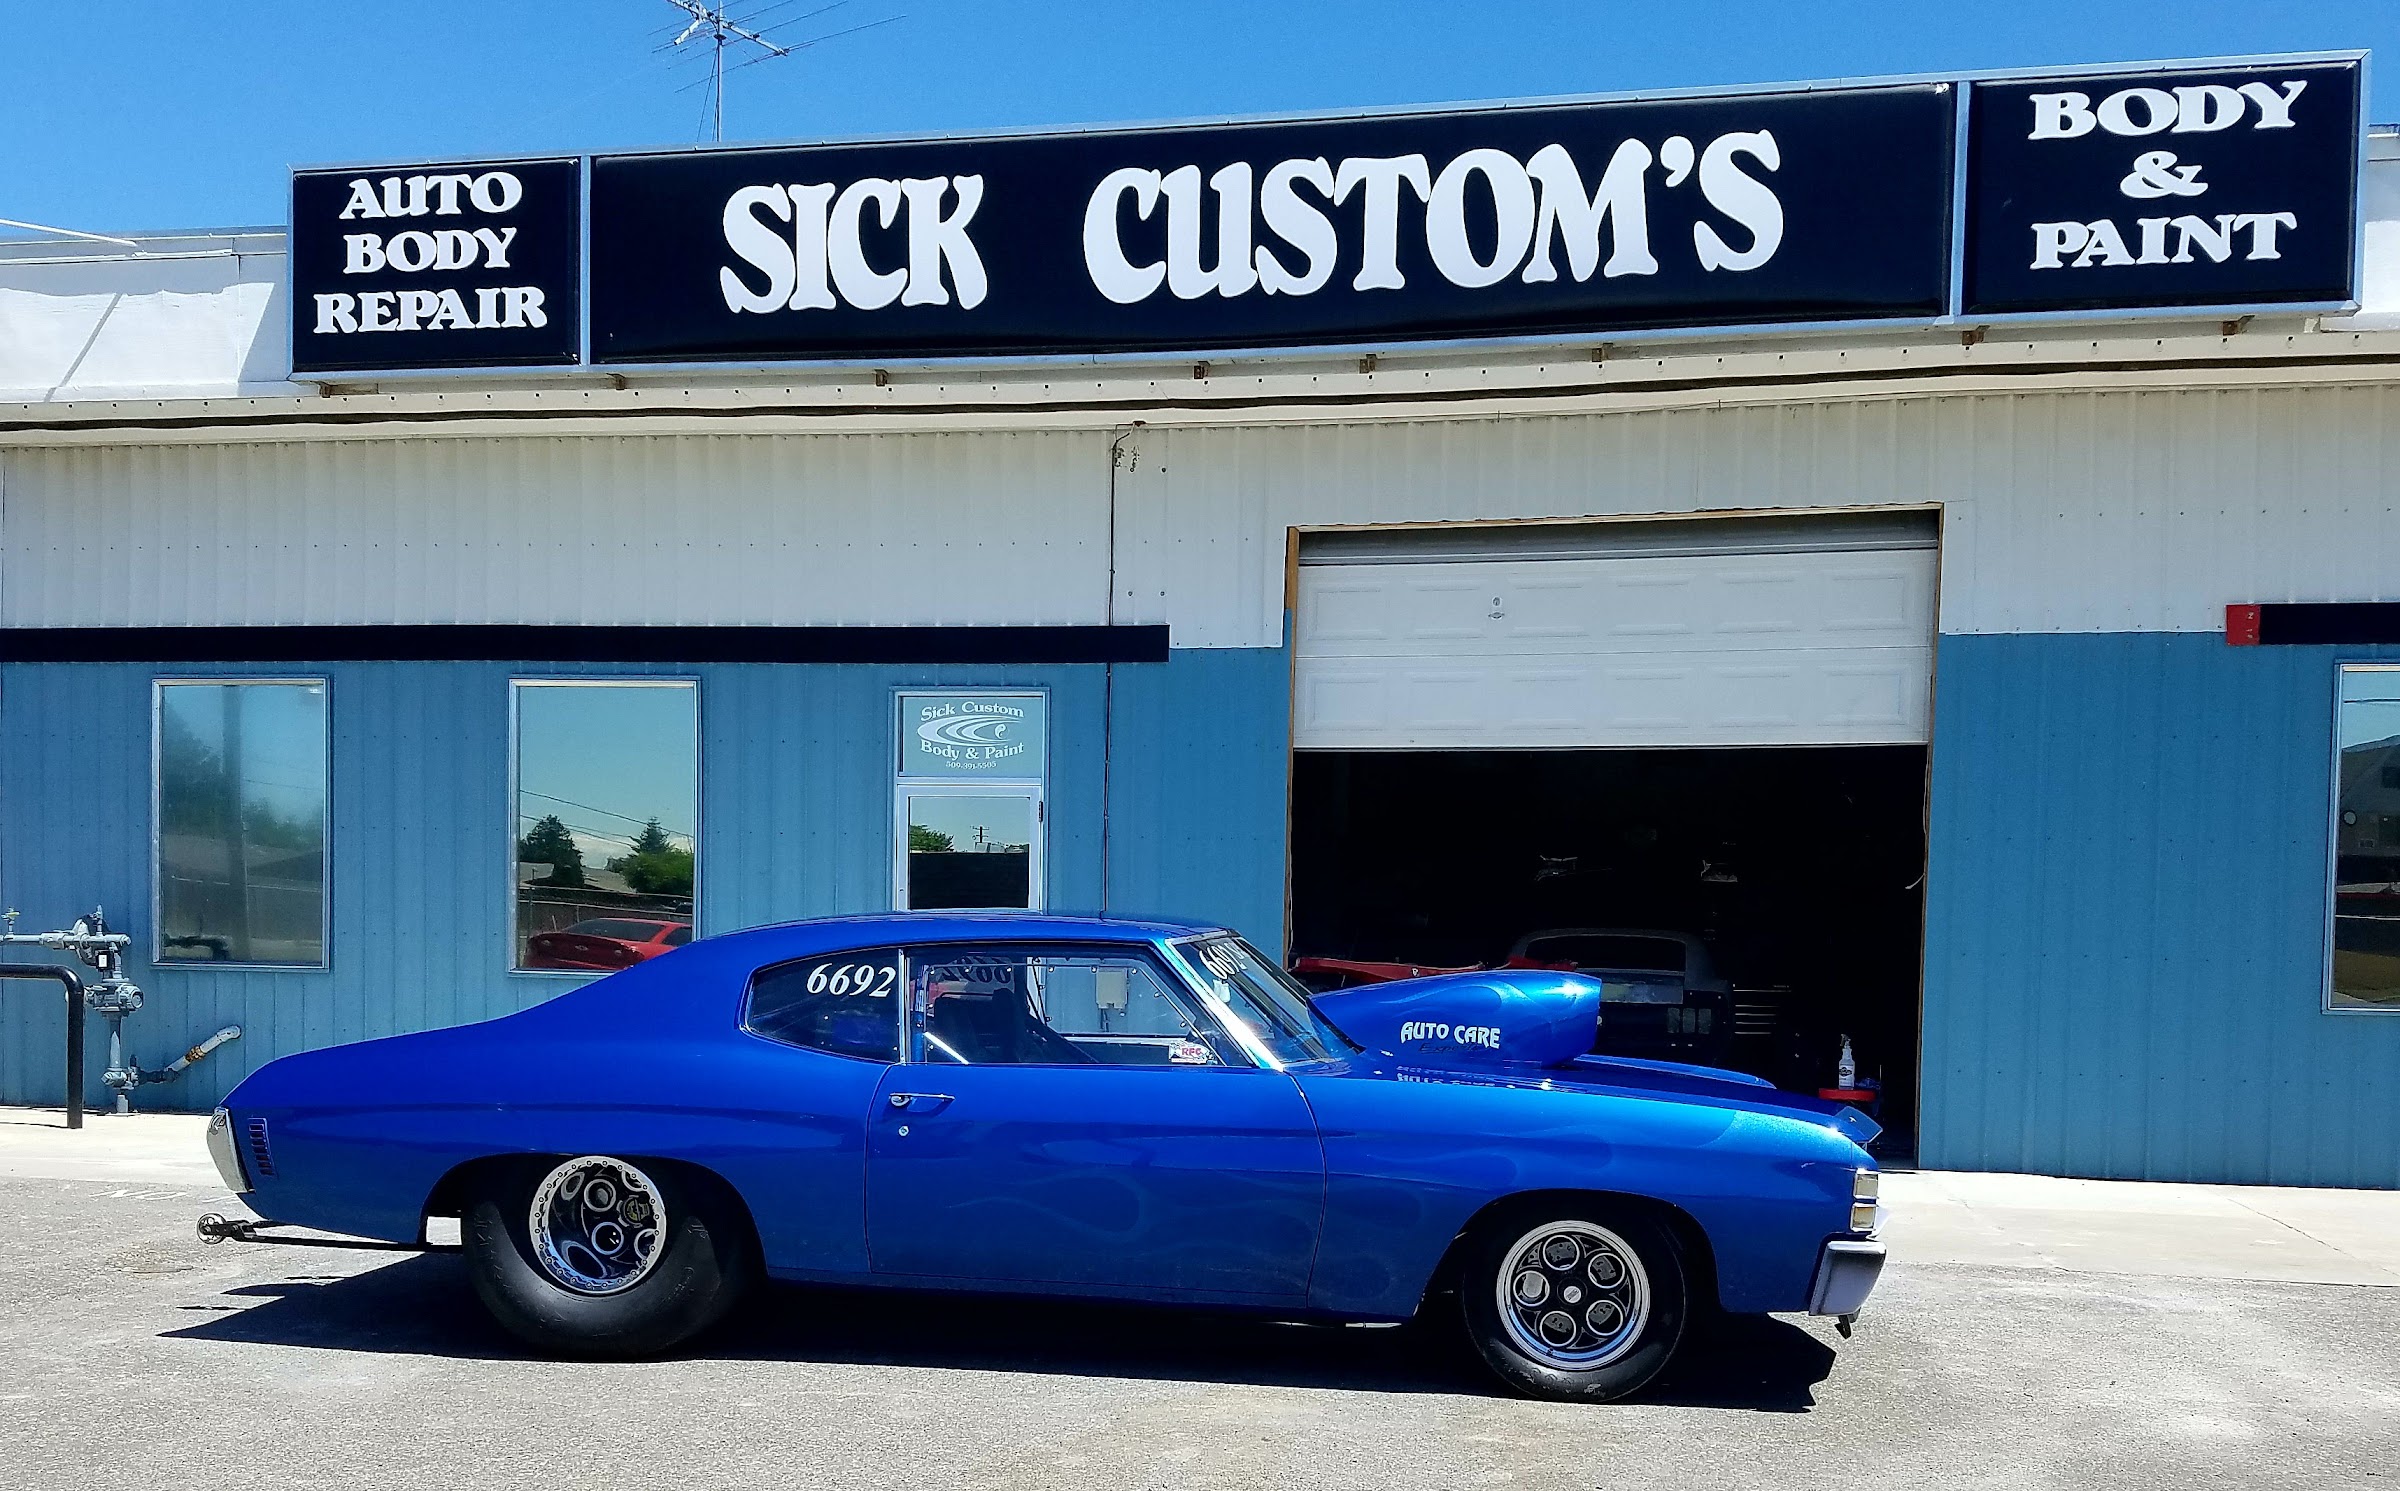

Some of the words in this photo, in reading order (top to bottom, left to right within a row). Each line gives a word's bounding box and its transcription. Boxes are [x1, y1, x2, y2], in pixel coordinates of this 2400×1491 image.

[2028, 80, 2308, 140] BODY
[338, 171, 522, 220] AUTO
[2120, 150, 2208, 199] &
[720, 174, 988, 314] SICK
[1083, 128, 1784, 304] CUSTOM'S
[2029, 211, 2298, 270] PAINT
[343, 227, 517, 274] BODY
[313, 287, 548, 335] REPAIR
[921, 703, 956, 721] Sick
[961, 701, 1024, 718] Custom
[921, 739, 960, 761] Body
[965, 747, 980, 760] &
[985, 742, 1024, 759] Paint
[806, 963, 896, 998] 6692
[1401, 1021, 1450, 1044] AUTO
[1453, 1025, 1501, 1050] CARE
